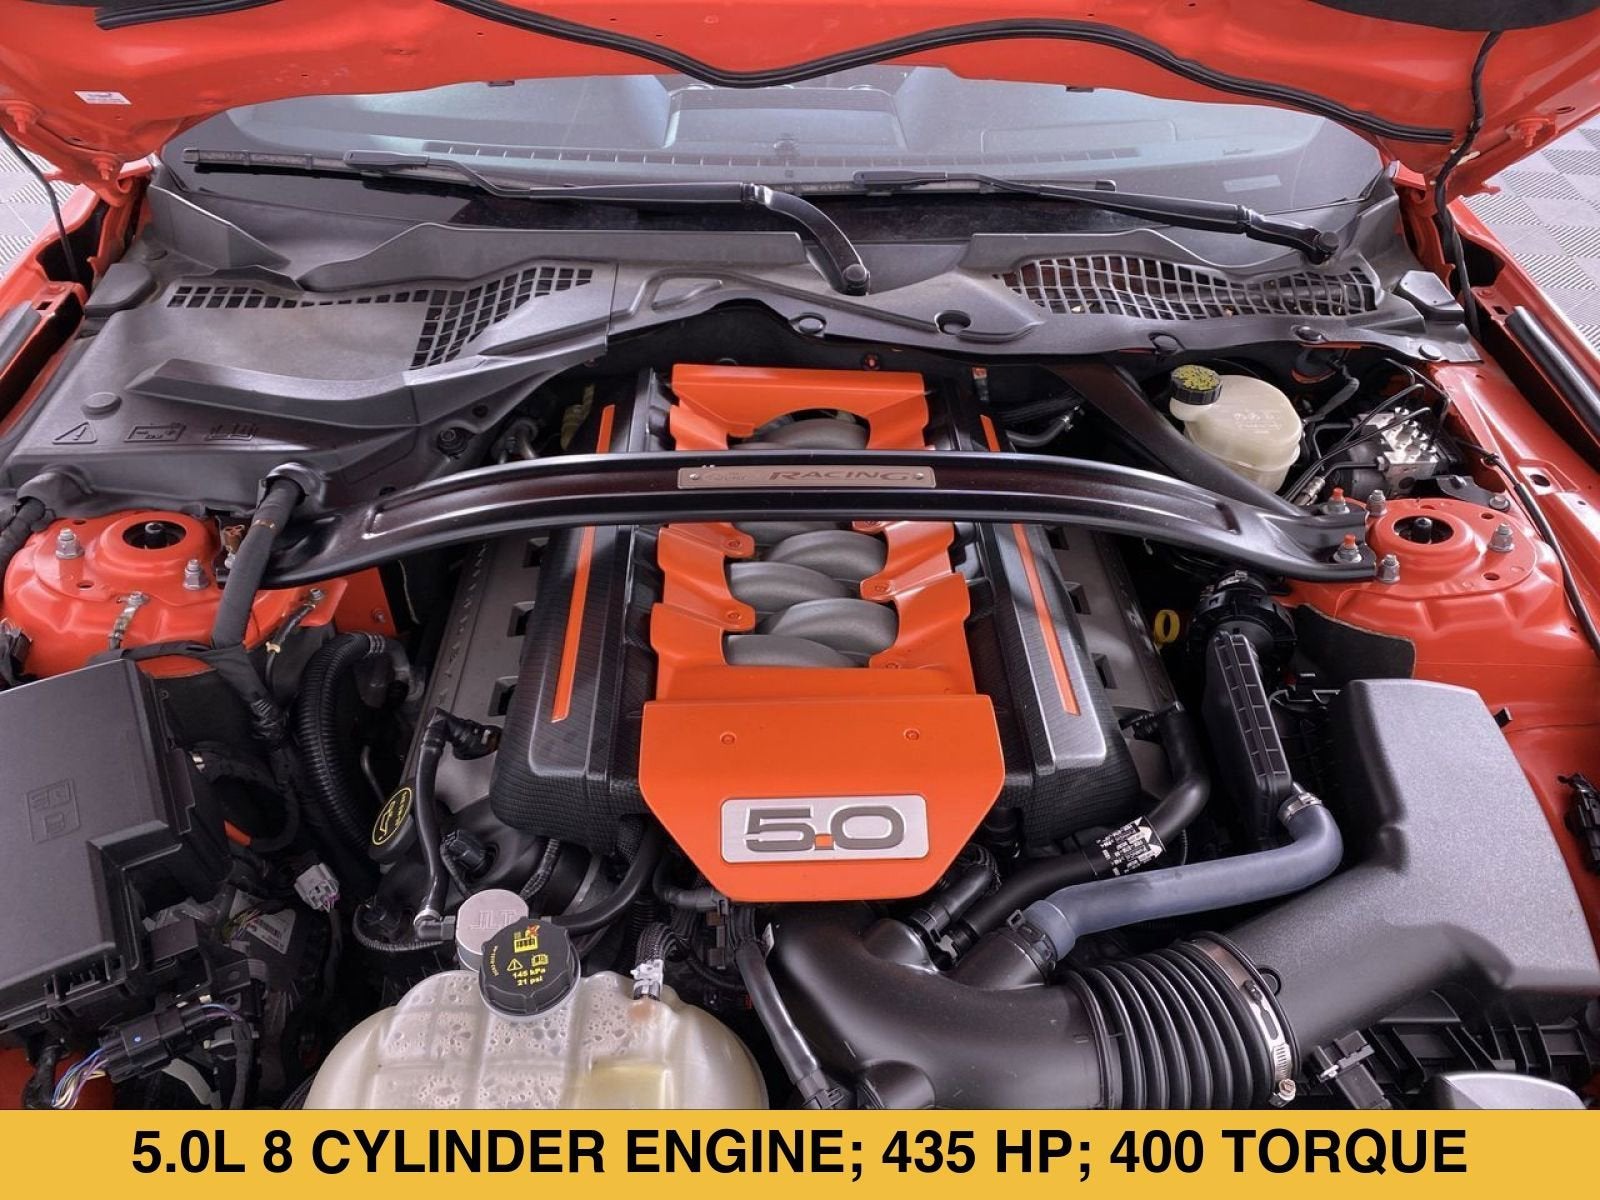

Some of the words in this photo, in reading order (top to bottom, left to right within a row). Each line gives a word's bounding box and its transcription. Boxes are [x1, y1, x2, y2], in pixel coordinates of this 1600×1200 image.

[768, 471, 911, 481] RACING
[745, 805, 906, 853] 5.0
[517, 978, 527, 987] 21
[529, 975, 543, 985] psi
